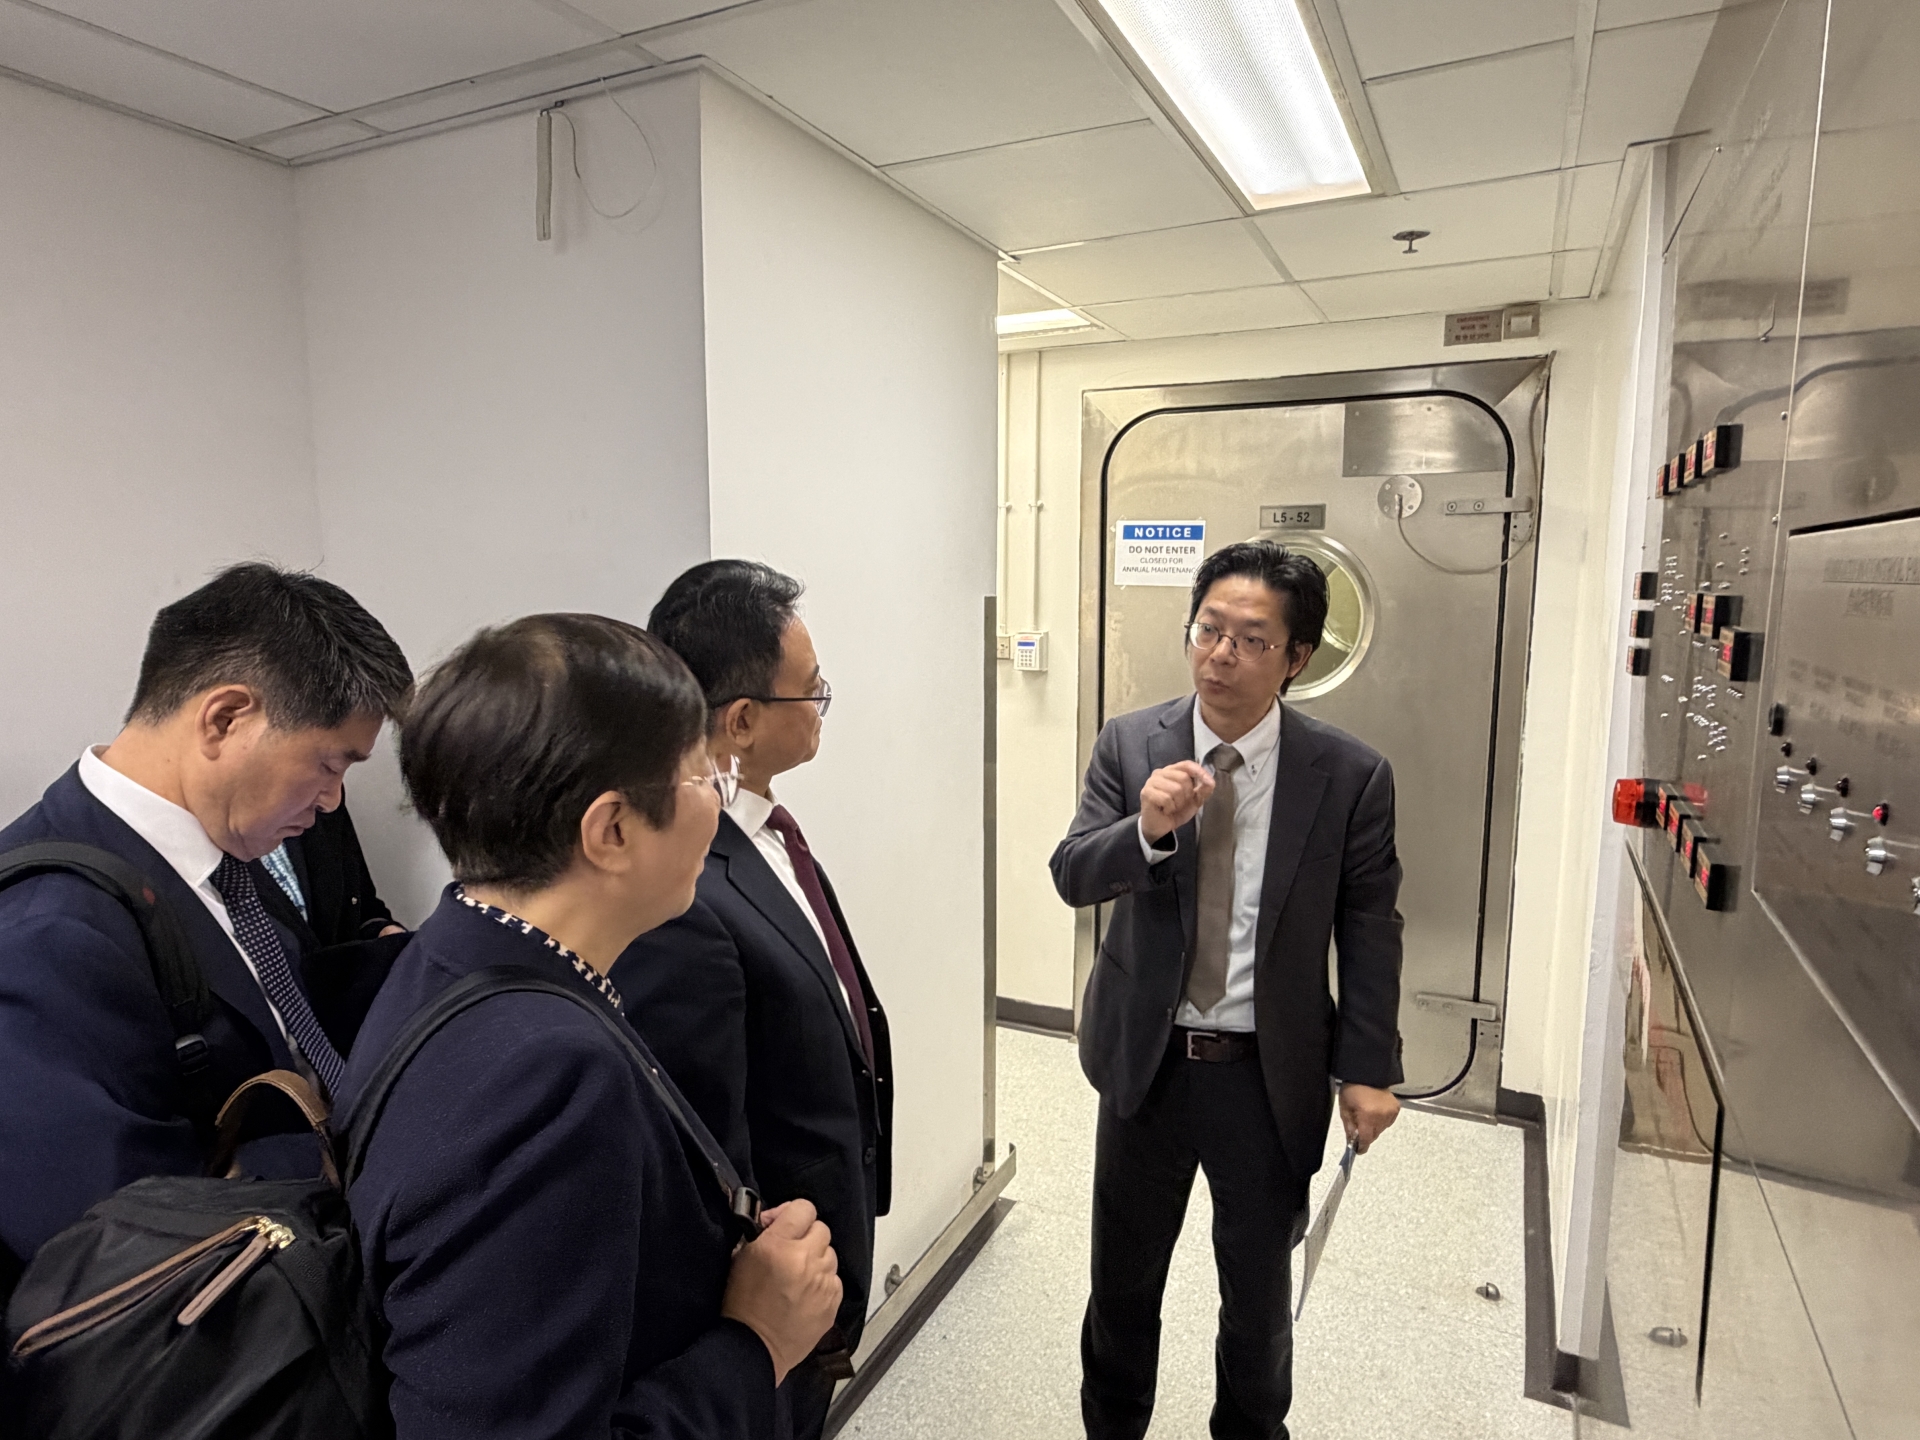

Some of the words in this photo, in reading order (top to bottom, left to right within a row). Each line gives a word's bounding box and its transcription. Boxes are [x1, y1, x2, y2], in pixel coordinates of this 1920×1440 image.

[1134, 527, 1192, 539] NOTICE
[1128, 545, 1143, 554] DO
[1144, 545, 1164, 554] NOT
[1165, 546, 1196, 555] ENTER
[1140, 557, 1168, 565] CLOSED
[1168, 558, 1183, 566] FOR
[1151, 567, 1195, 575] MAINTENANC
